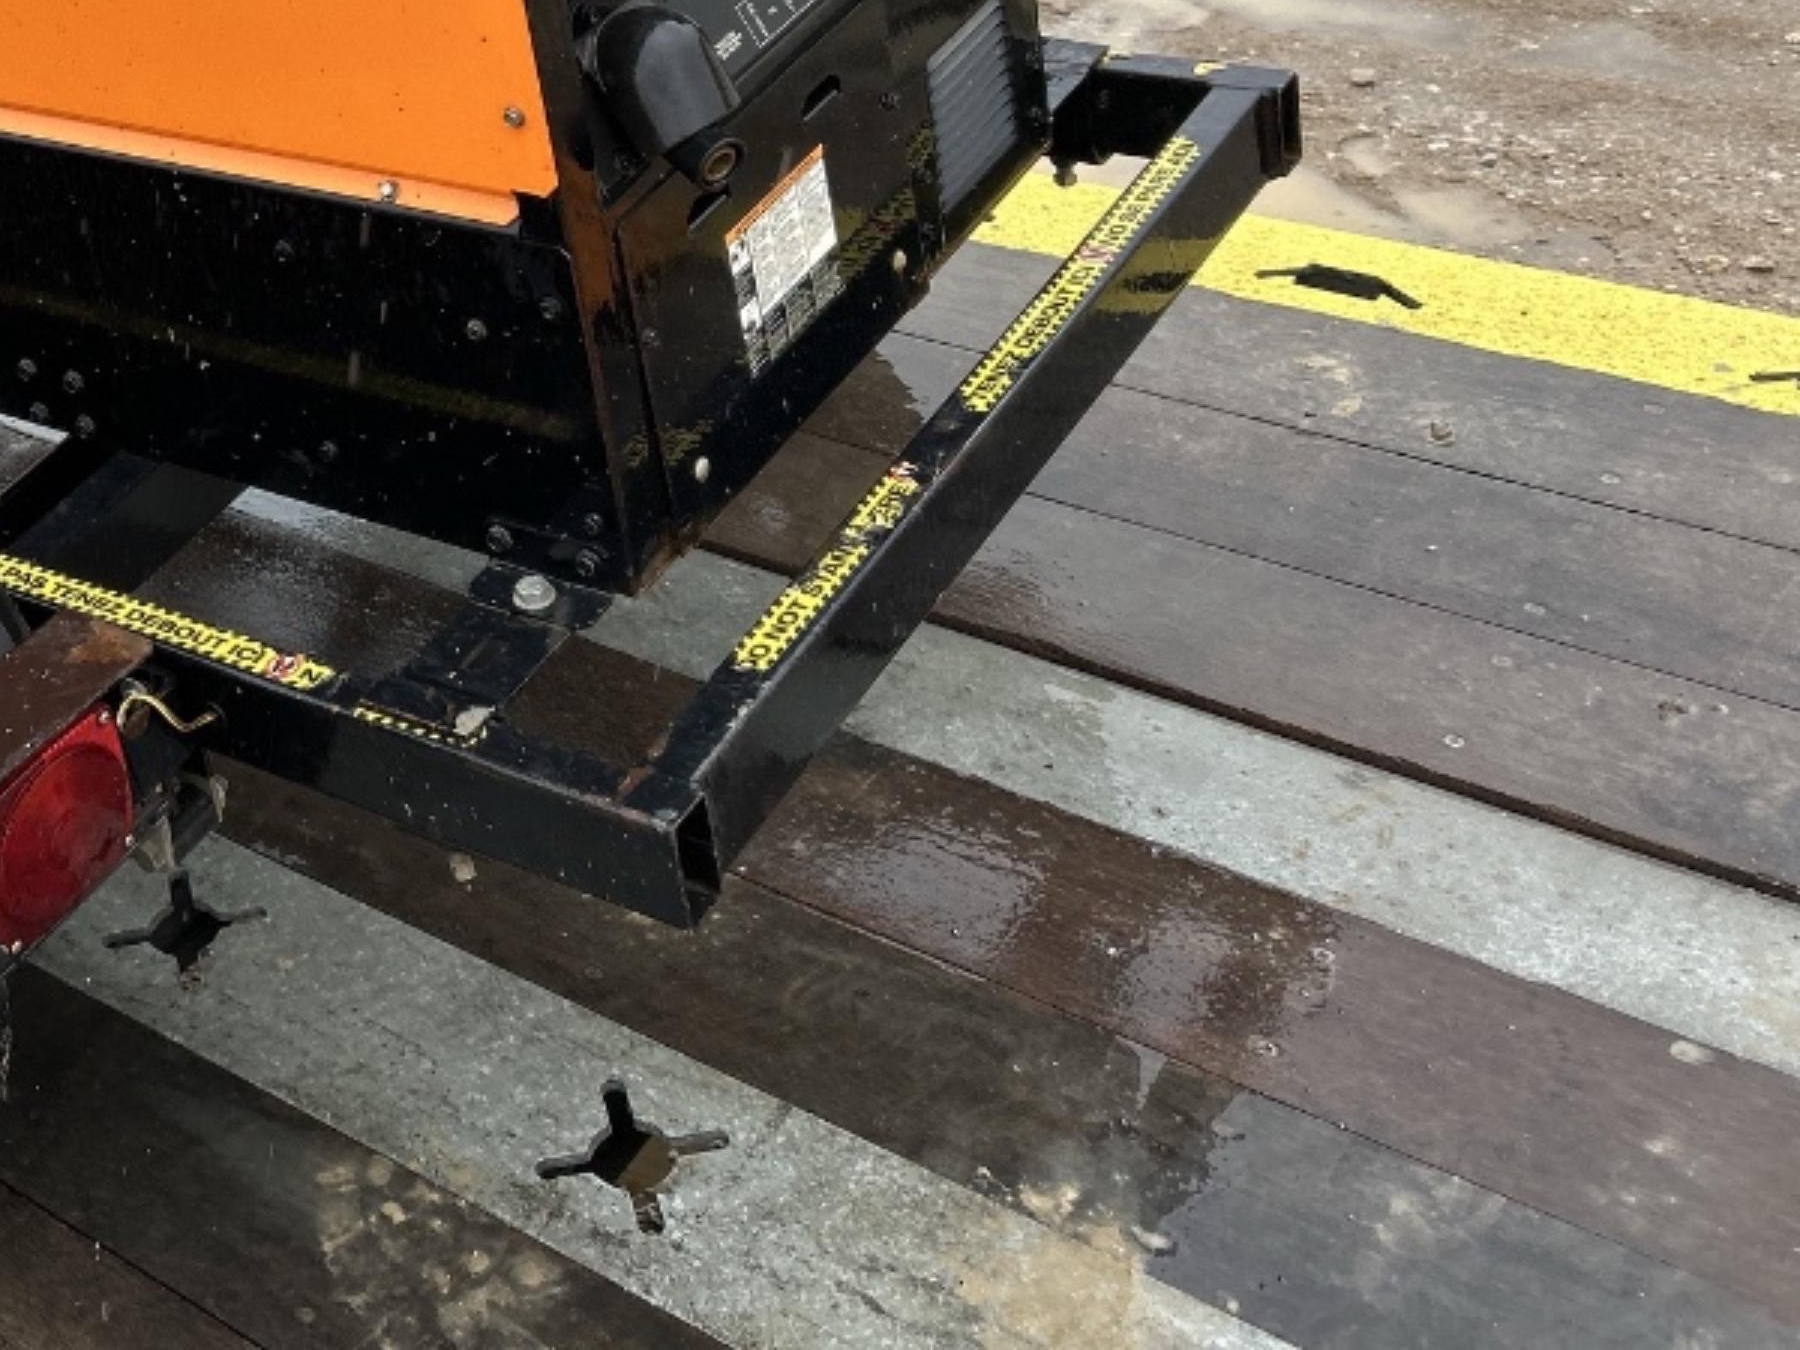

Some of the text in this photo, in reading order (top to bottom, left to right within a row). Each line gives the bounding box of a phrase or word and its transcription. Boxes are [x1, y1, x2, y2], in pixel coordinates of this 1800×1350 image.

[3, 565, 50, 589] PAS
[125, 607, 225, 649] DEBOUT
[762, 600, 808, 640] NOT
